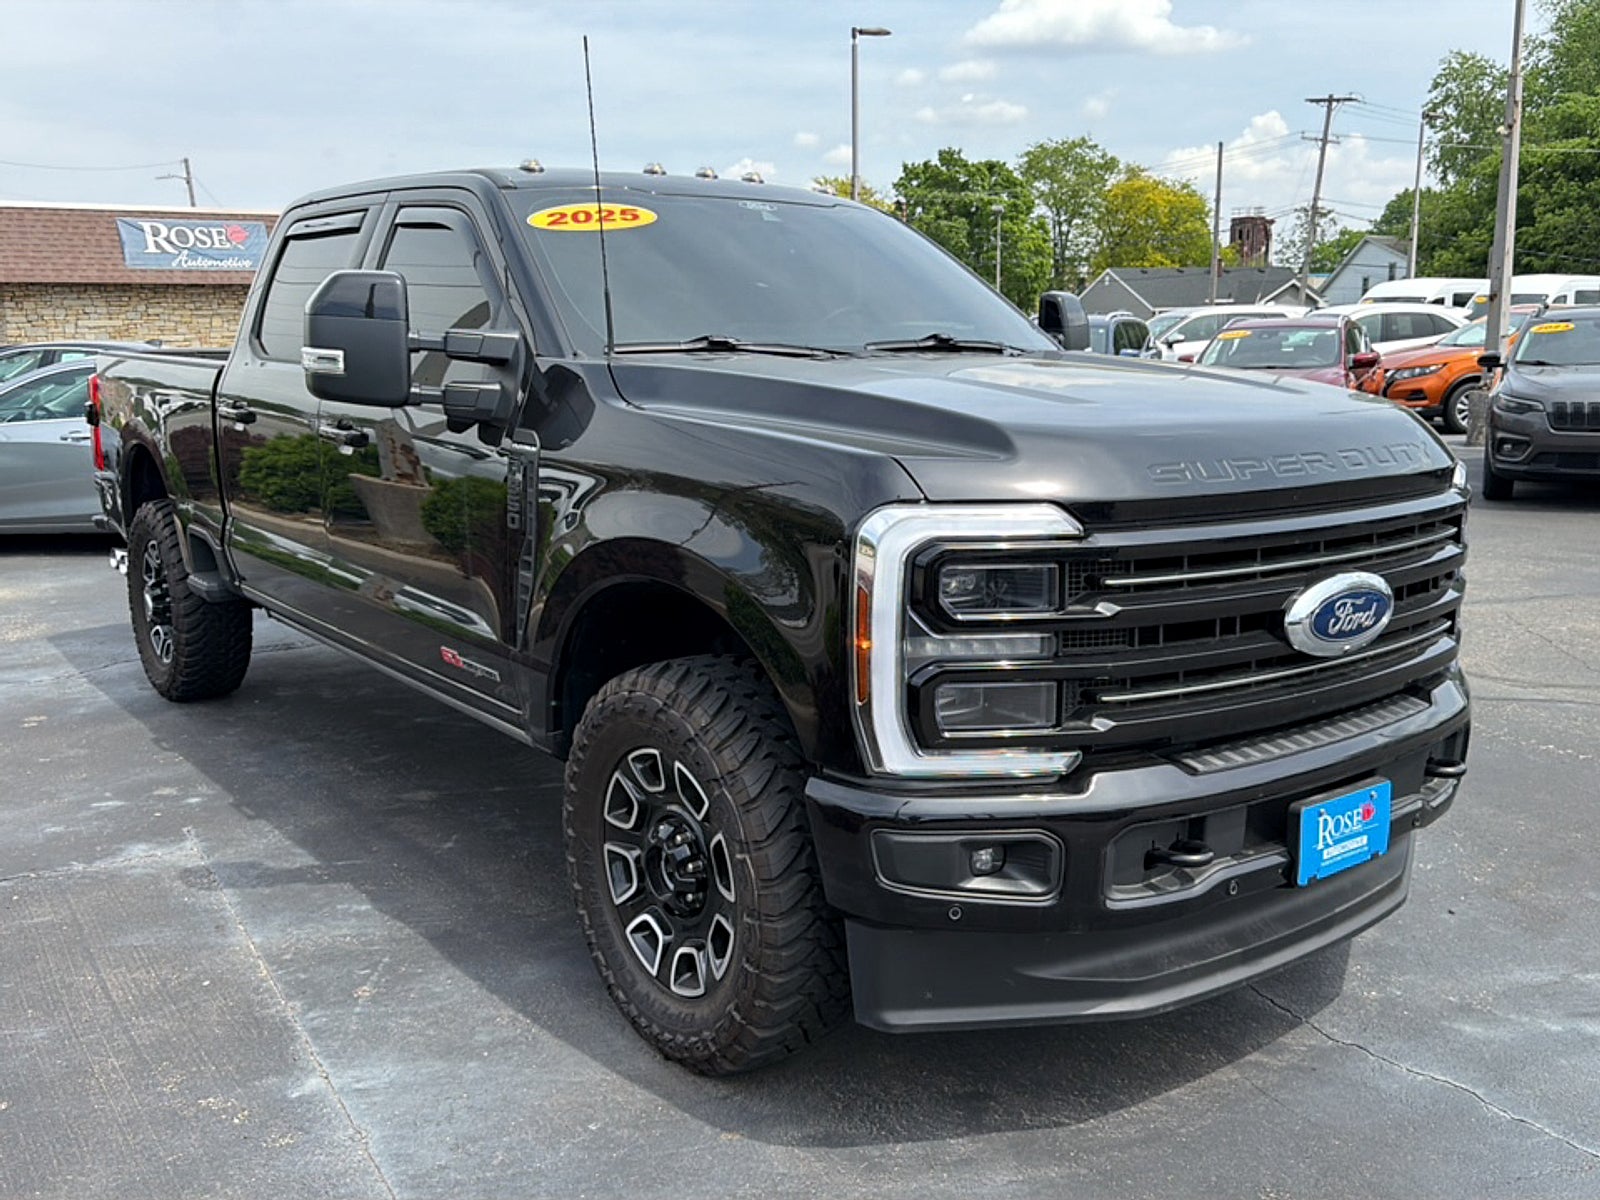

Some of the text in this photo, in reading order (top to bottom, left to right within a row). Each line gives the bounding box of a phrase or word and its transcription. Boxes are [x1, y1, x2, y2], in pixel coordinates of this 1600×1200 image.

[546, 208, 640, 226] 2025
[138, 221, 231, 254] ROSE
[171, 249, 252, 268] Automotive
[1148, 442, 1432, 485] SUPER DUTY
[1328, 597, 1377, 634] Ford
[1317, 808, 1363, 850] ROSE
